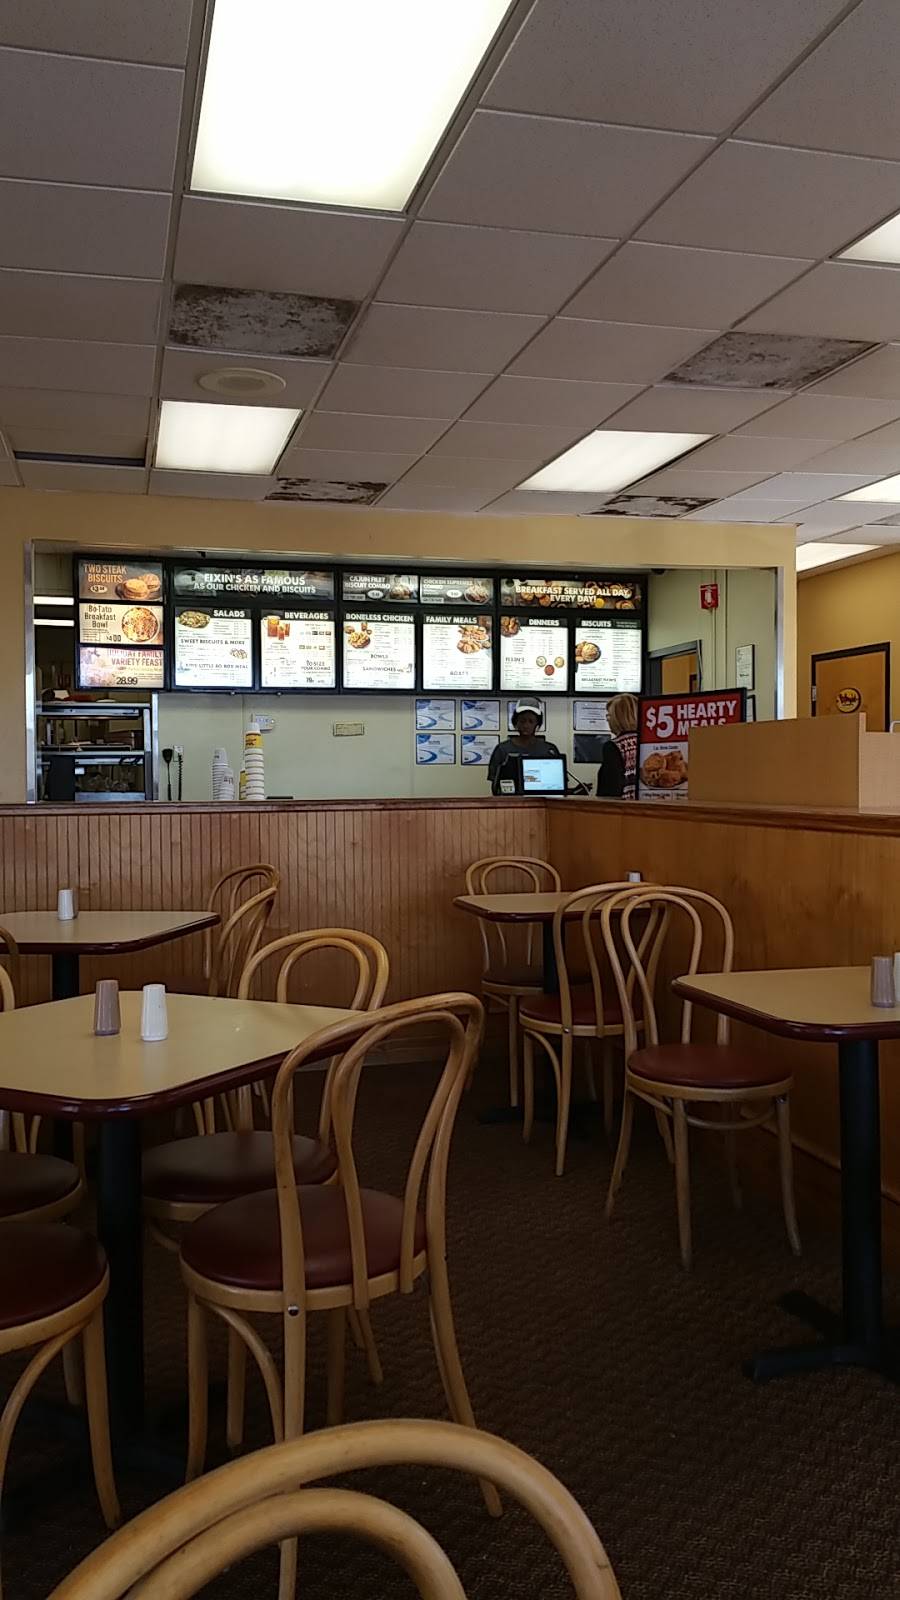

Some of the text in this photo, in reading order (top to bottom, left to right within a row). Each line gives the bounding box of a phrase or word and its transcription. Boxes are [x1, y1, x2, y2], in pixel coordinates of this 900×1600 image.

[84, 564, 127, 574] TWO STEAK
[88, 573, 123, 583] BISCUITS
[245, 575, 258, 584] AS
[261, 575, 306, 586] FAMOUS
[225, 584, 260, 592] CHICKEN
[282, 585, 316, 593] BISCUITS
[515, 586, 562, 594] BREAKFAST
[564, 586, 594, 595] SERVED
[596, 588, 611, 596] ALL
[550, 594, 596, 603] EVERY DAY!
[88, 605, 112, 613] Bo-Tato
[213, 609, 245, 617] SALADS
[84, 612, 116, 621] Breakfast
[284, 612, 329, 620] BEVERAGES
[345, 613, 414, 622] BONELESS CHICKEN
[453, 616, 477, 624] MEALS
[528, 618, 560, 626] DINNERS
[581, 620, 612, 628] BISCUITS
[112, 658, 162, 666] VARIETY FEAST
[676, 700, 738, 719] HEARTY
[646, 704, 675, 738] $5
